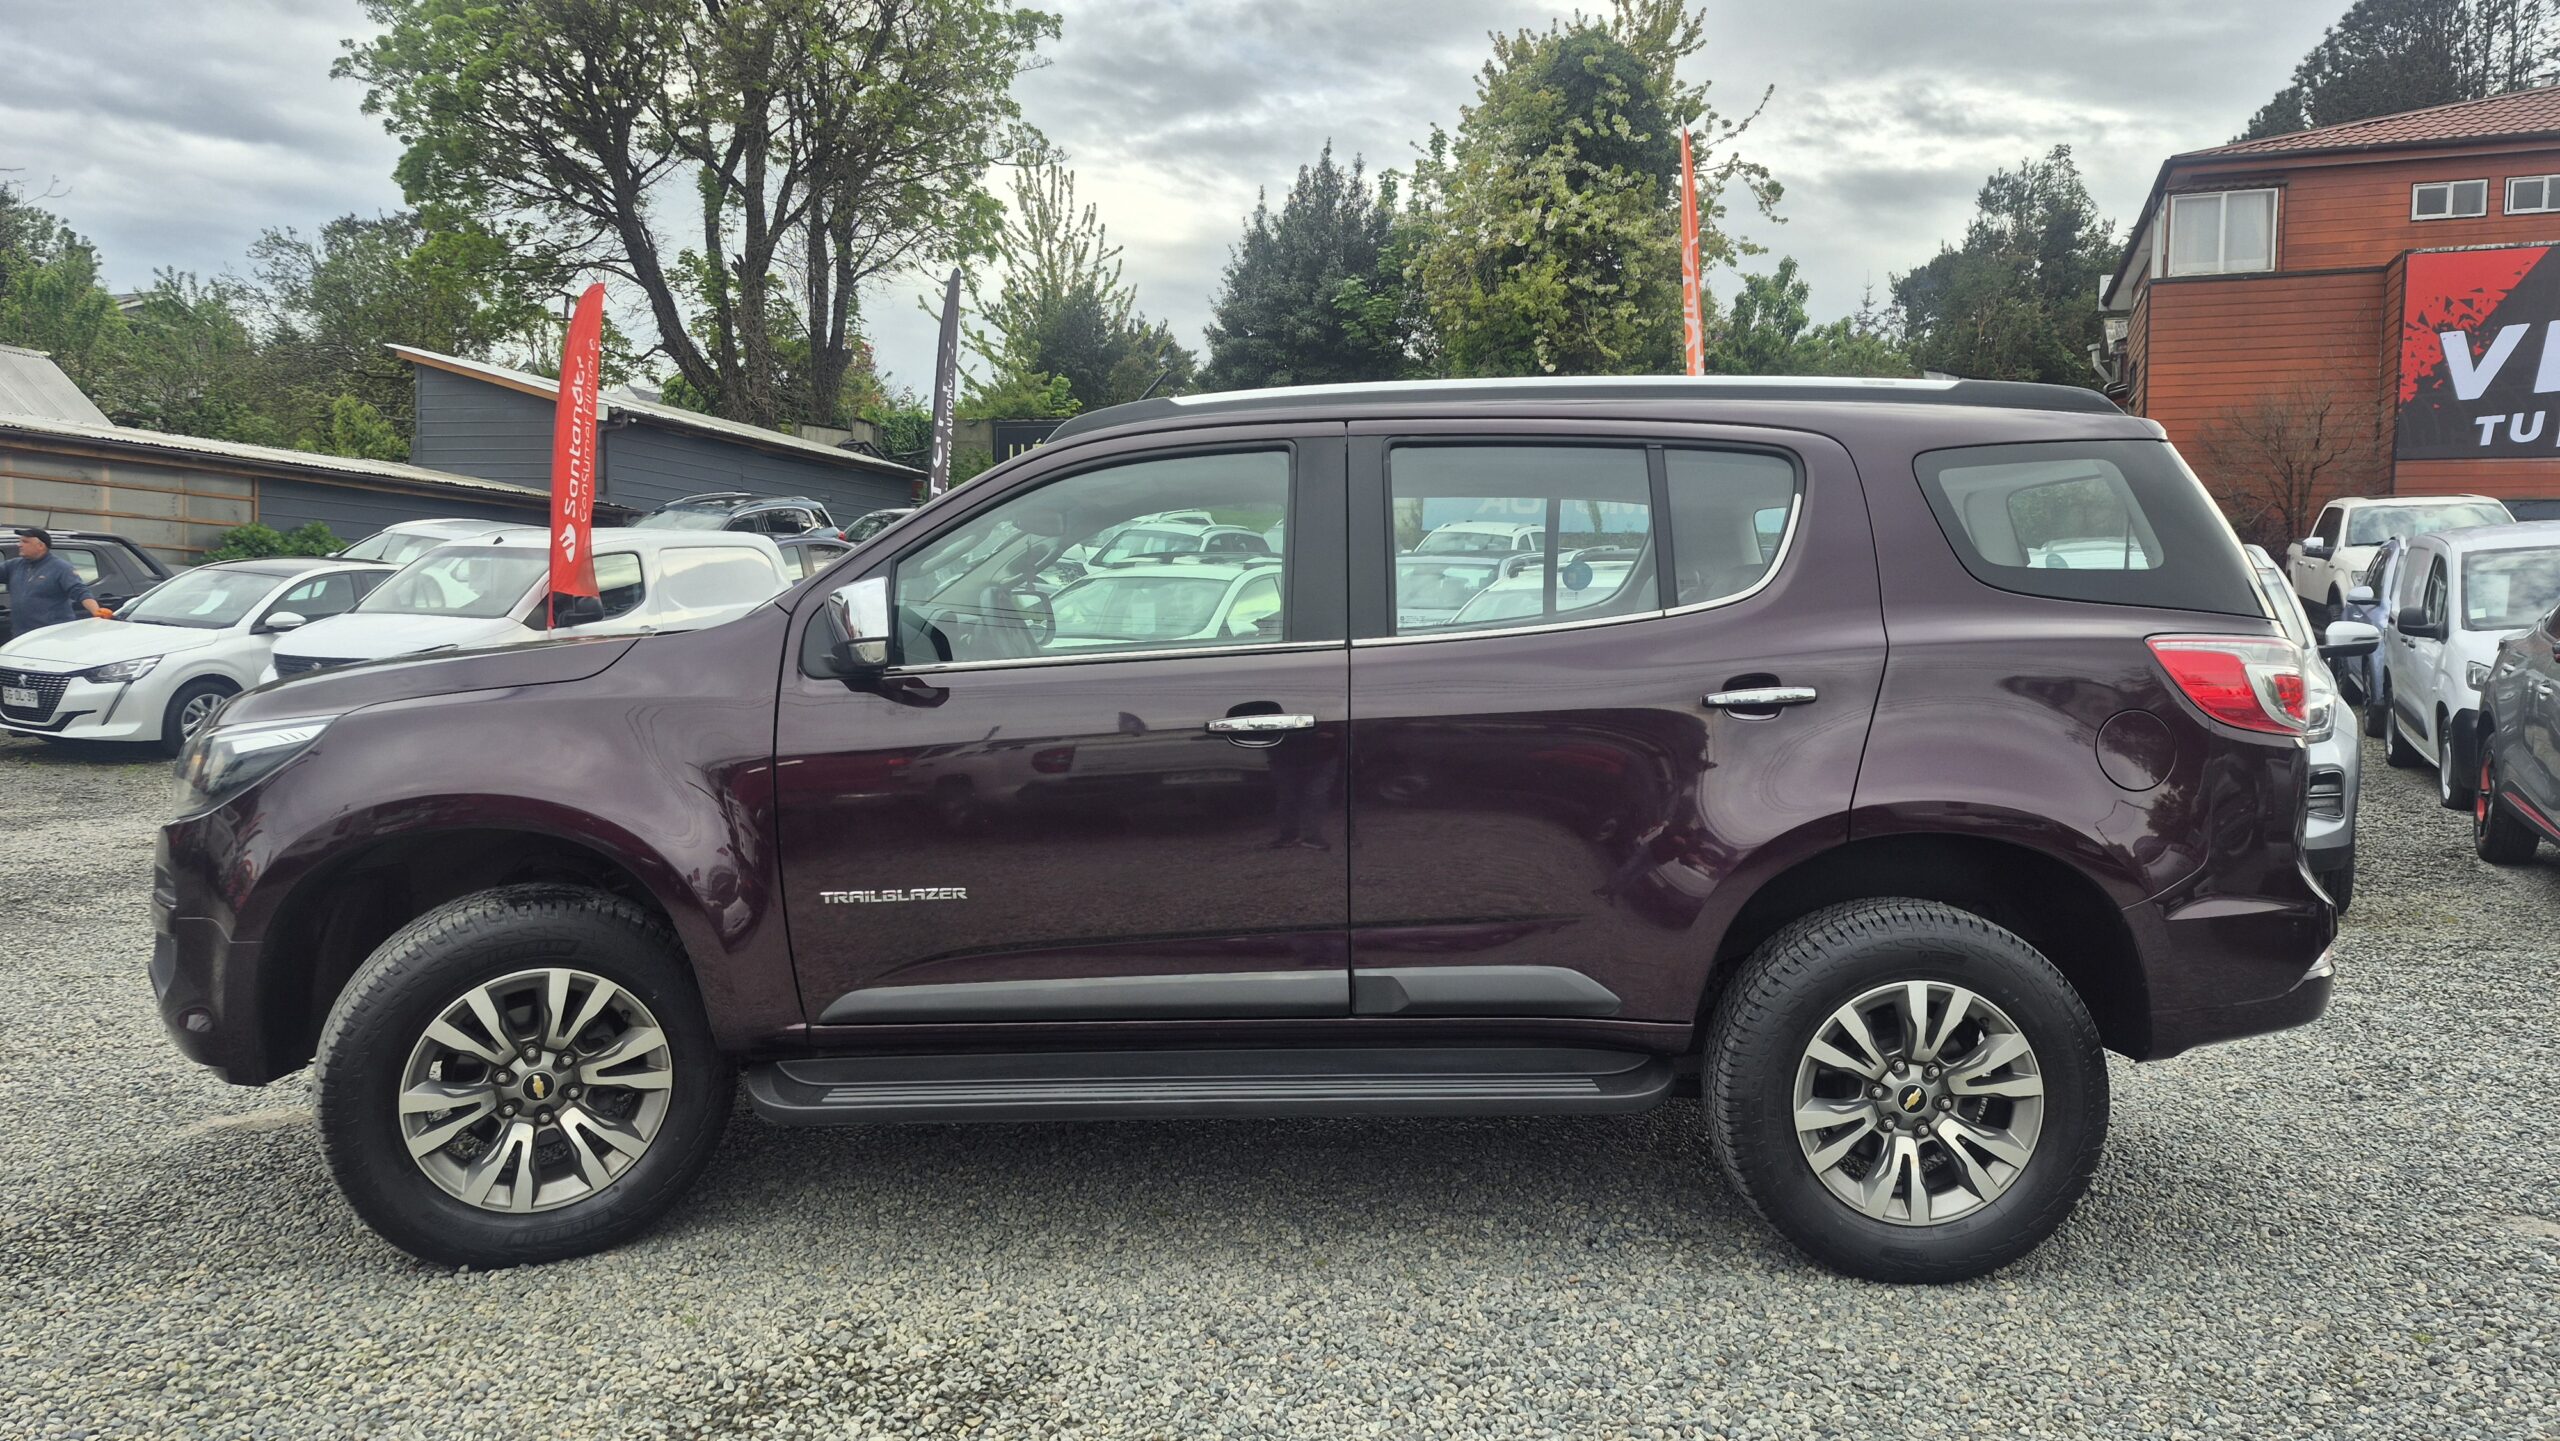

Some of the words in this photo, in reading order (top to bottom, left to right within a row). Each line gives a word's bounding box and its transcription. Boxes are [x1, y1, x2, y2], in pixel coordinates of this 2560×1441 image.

[564, 355, 585, 518] Santander
[2475, 410, 2560, 448] TU
[820, 887, 967, 904] TRAILBLAZER
